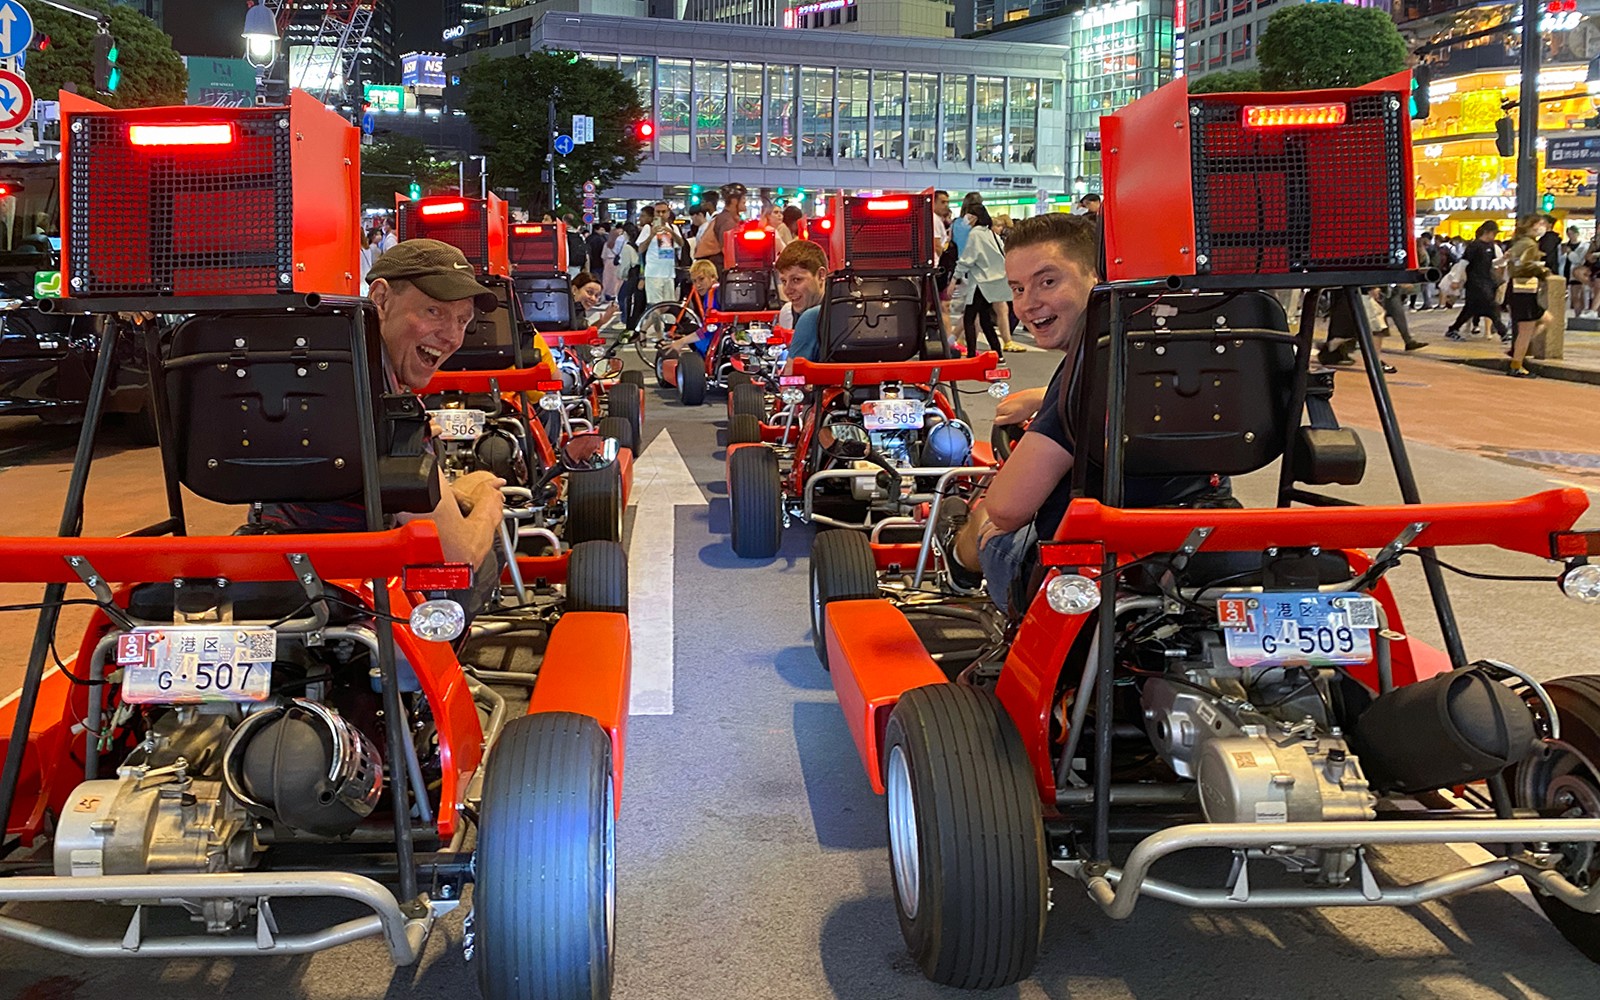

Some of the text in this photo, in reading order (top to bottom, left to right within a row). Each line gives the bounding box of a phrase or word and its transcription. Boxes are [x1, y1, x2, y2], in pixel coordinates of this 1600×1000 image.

[442, 25, 464, 39] GMO
[424, 60, 443, 72] NS
[1277, 602, 1314, 618] 港区
[181, 636, 219, 653] 港区
